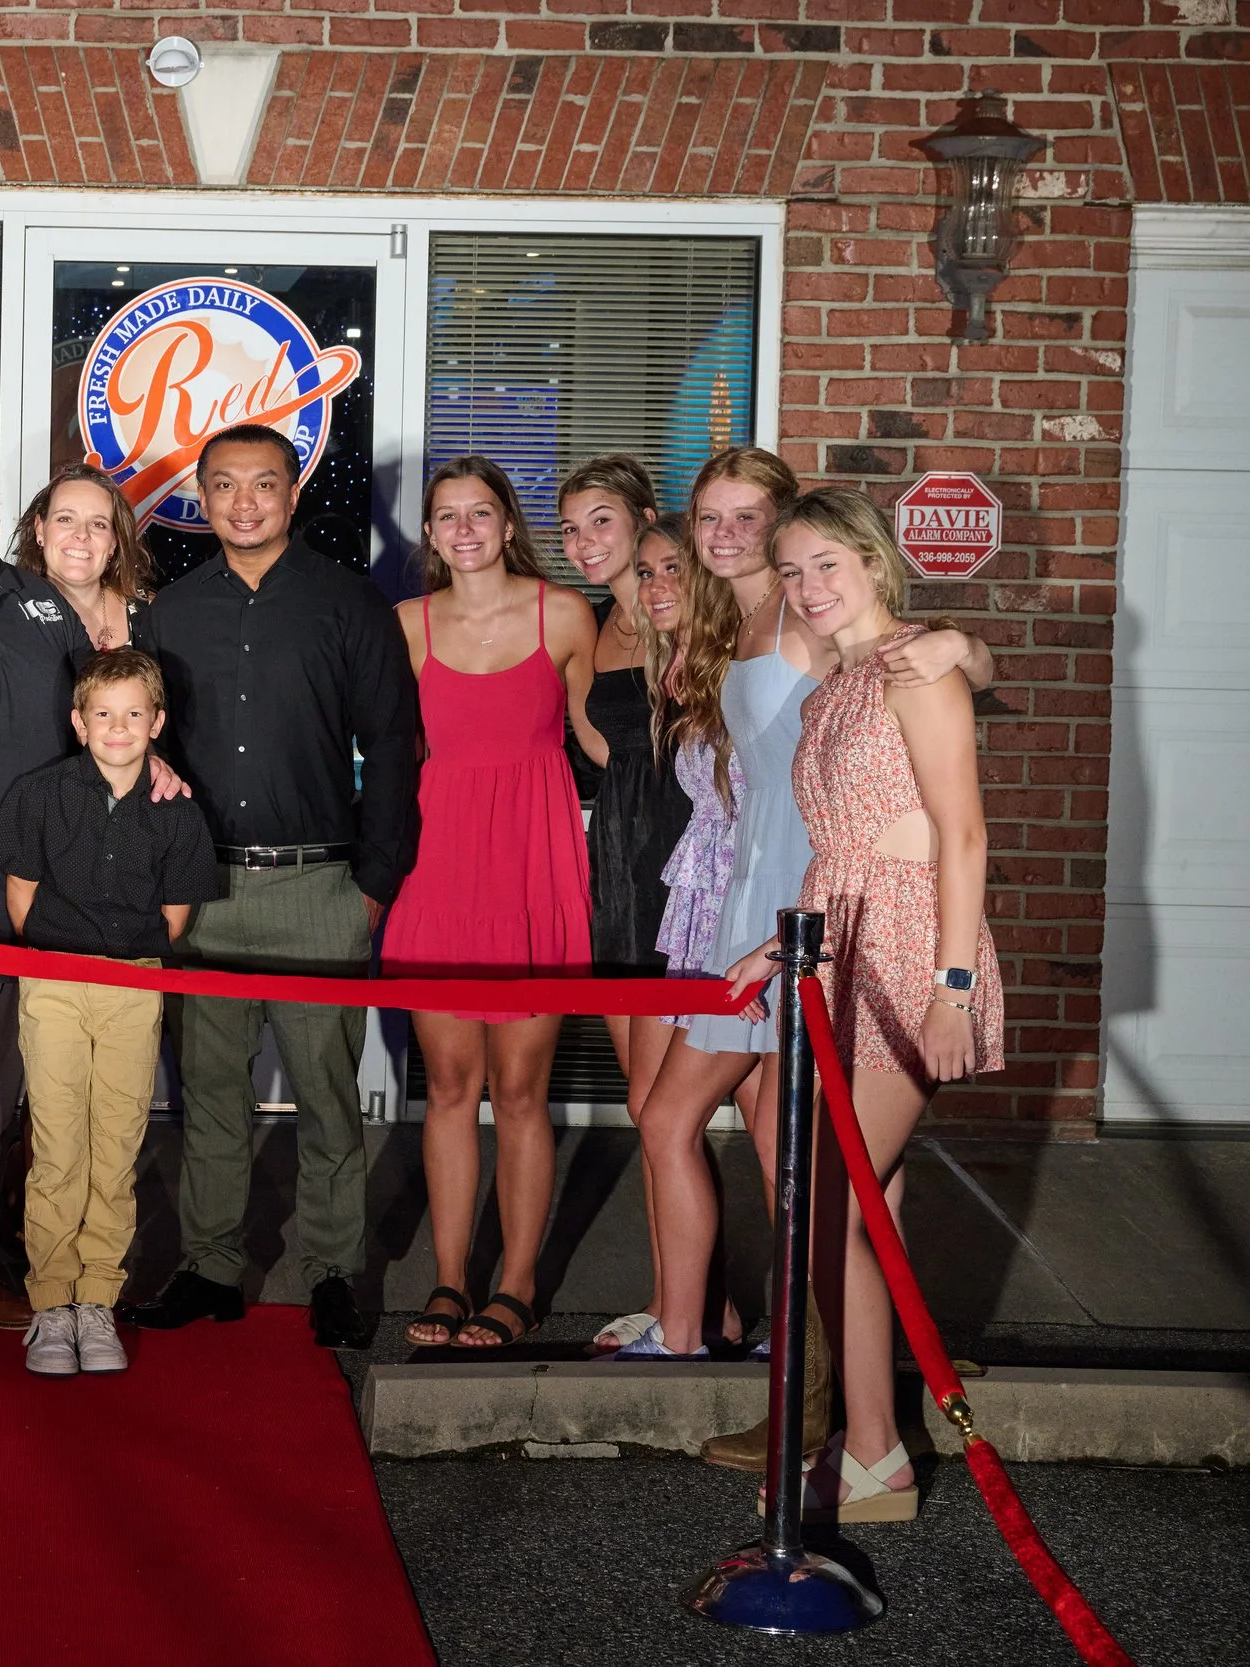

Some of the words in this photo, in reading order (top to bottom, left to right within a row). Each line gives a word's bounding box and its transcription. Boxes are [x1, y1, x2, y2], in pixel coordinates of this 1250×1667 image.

[88, 343, 121, 426] FRESH
[113, 291, 181, 345] MADE
[187, 287, 261, 316] DAILY
[906, 508, 990, 528] DAVIE
[908, 529, 941, 541] ALARM
[942, 529, 988, 542] COMPANY
[918, 551, 976, 563] 336-998-2059
